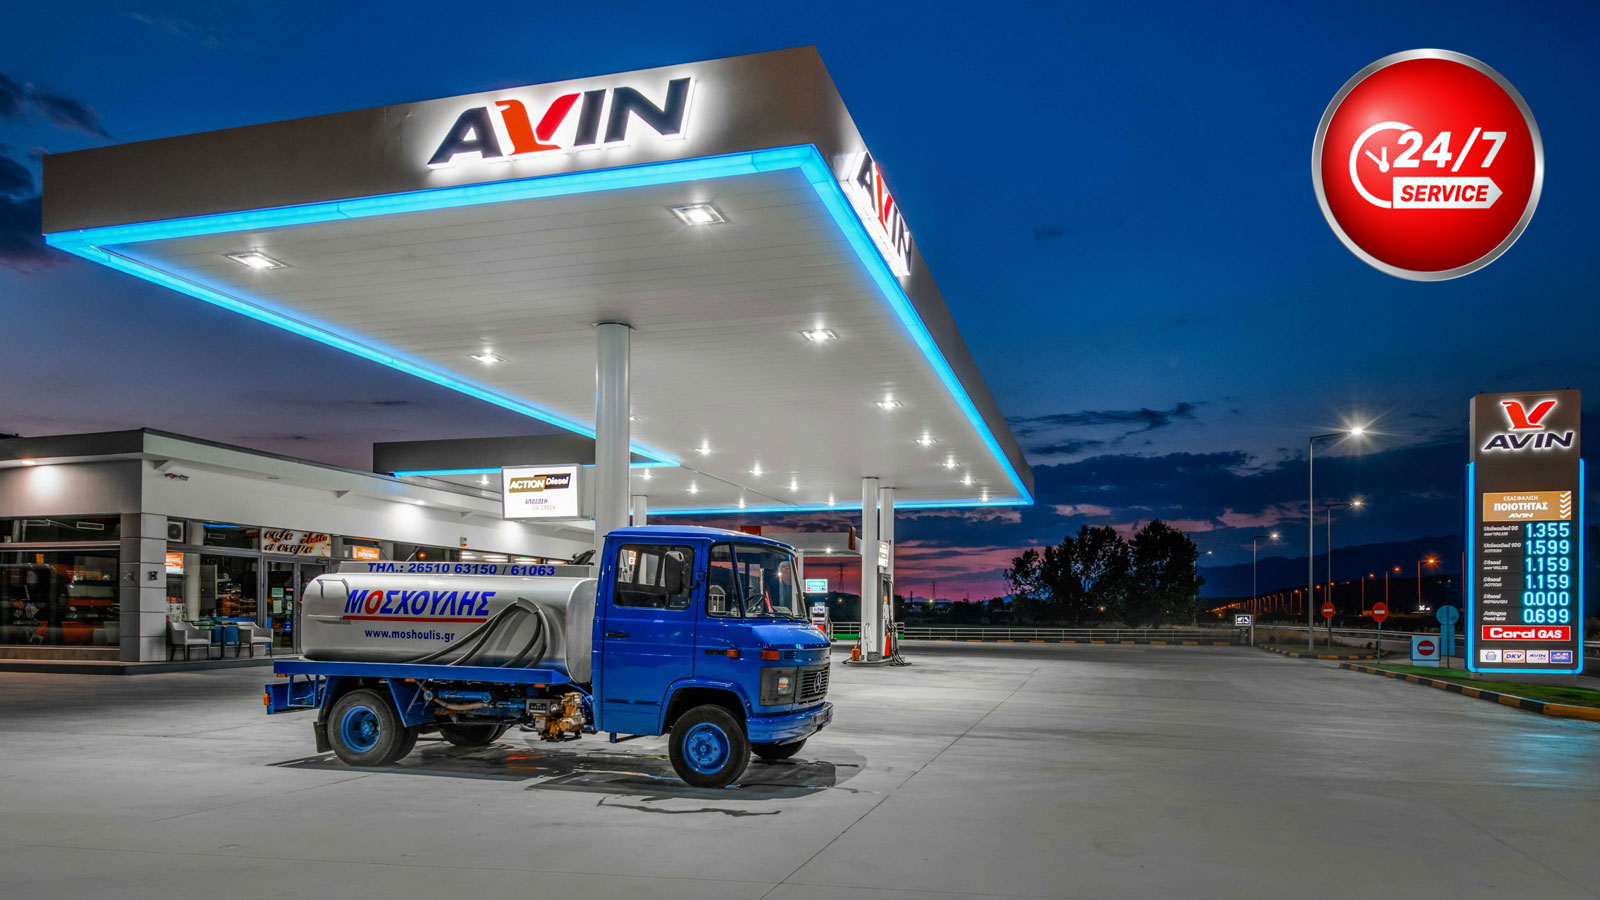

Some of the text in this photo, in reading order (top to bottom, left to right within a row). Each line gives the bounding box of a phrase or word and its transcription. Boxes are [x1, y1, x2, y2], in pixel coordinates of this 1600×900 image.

[427, 77, 694, 168] AVIN
[1482, 431, 1574, 451] AVIN
[510, 476, 569, 489] ACTION Diesel
[1494, 502, 1548, 511] ΠΟΙΟΤΗΤΑΣ
[1526, 523, 1570, 538] 1.355
[1526, 540, 1570, 555] 1.599
[408, 562, 450, 574] 26510
[454, 564, 497, 575] 63150
[511, 565, 555, 576] 61063
[1526, 557, 1569, 572] 1.159
[1526, 574, 1569, 589] 1.159
[344, 589, 496, 616] ΜΟΣΧΟΥΛΗΣ
[1524, 591, 1569, 606] 0.000
[1524, 609, 1569, 623] 0.699
[365, 629, 455, 642] www.moshoulis.gr
[1490, 627, 1562, 639] Coral GAS
